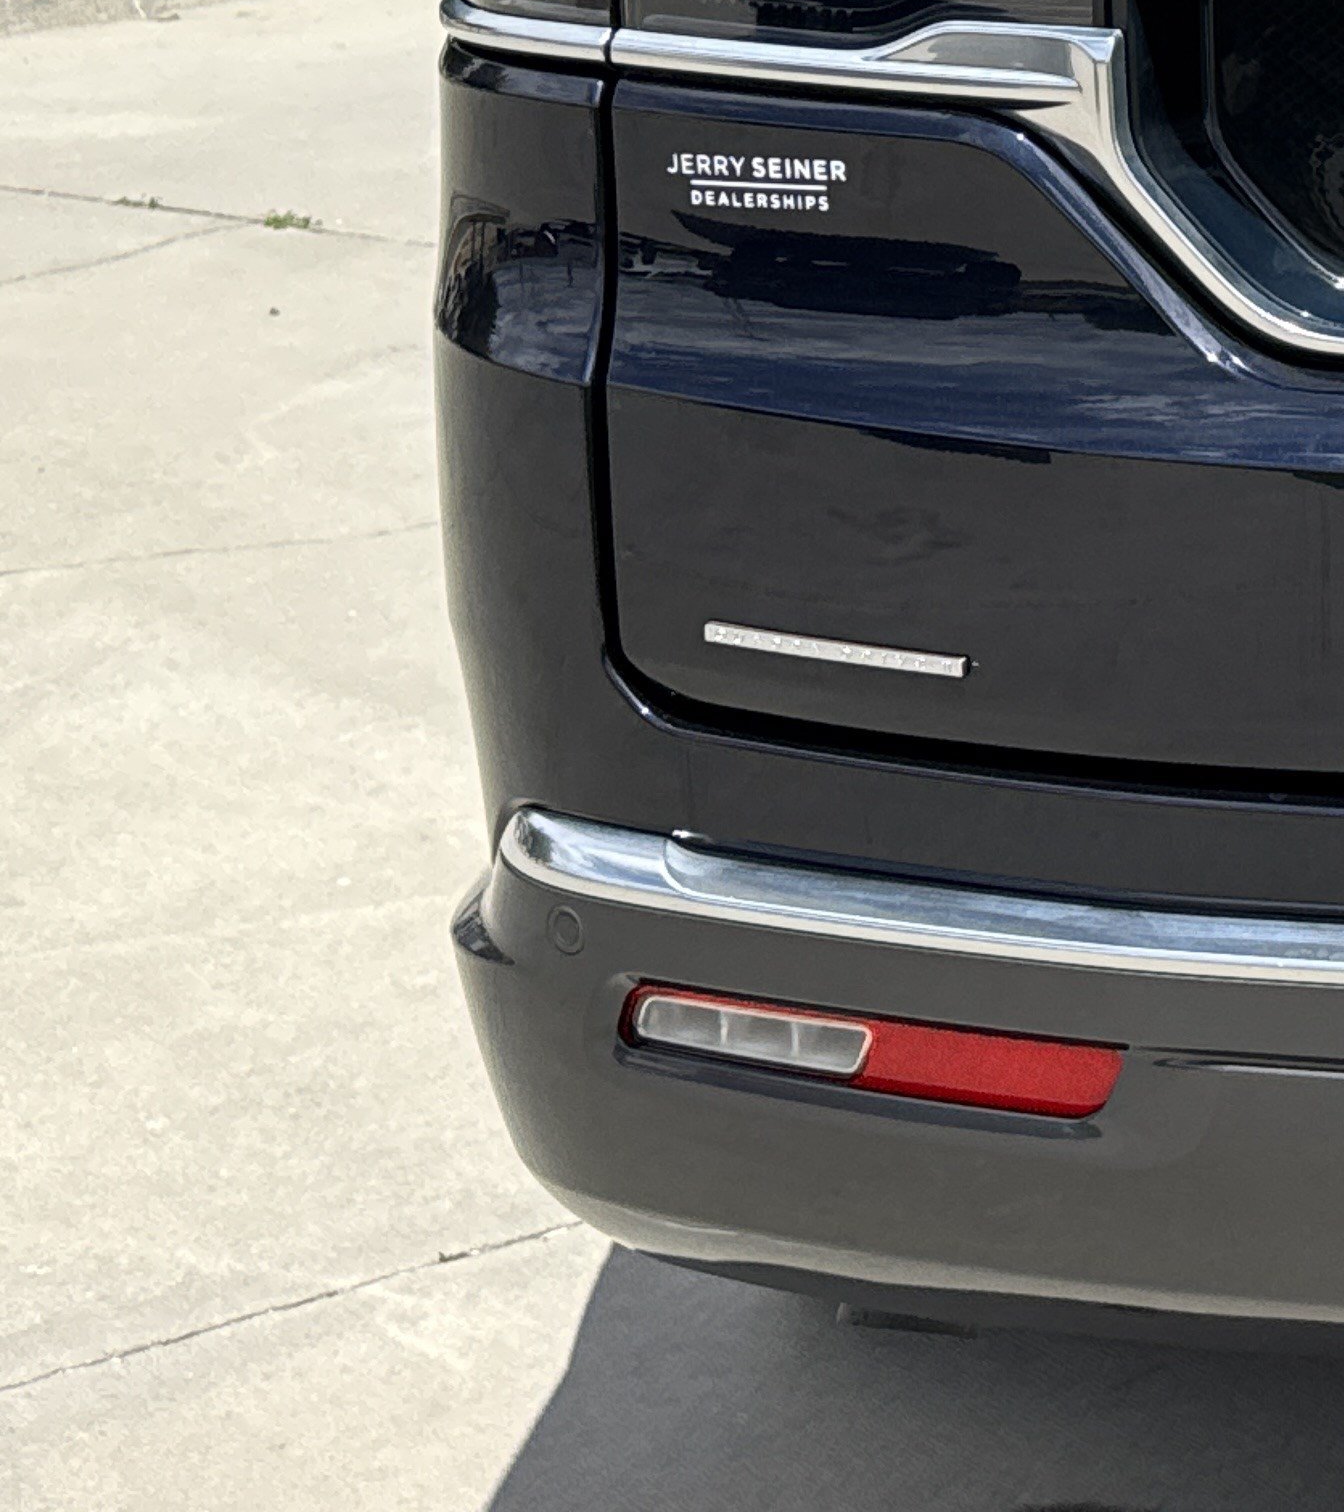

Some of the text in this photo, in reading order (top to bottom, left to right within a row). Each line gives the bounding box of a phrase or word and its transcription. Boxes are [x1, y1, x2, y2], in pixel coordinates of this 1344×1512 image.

[667, 153, 847, 182] JERRY SEINER
[691, 190, 829, 211] DEALERSHIPS
